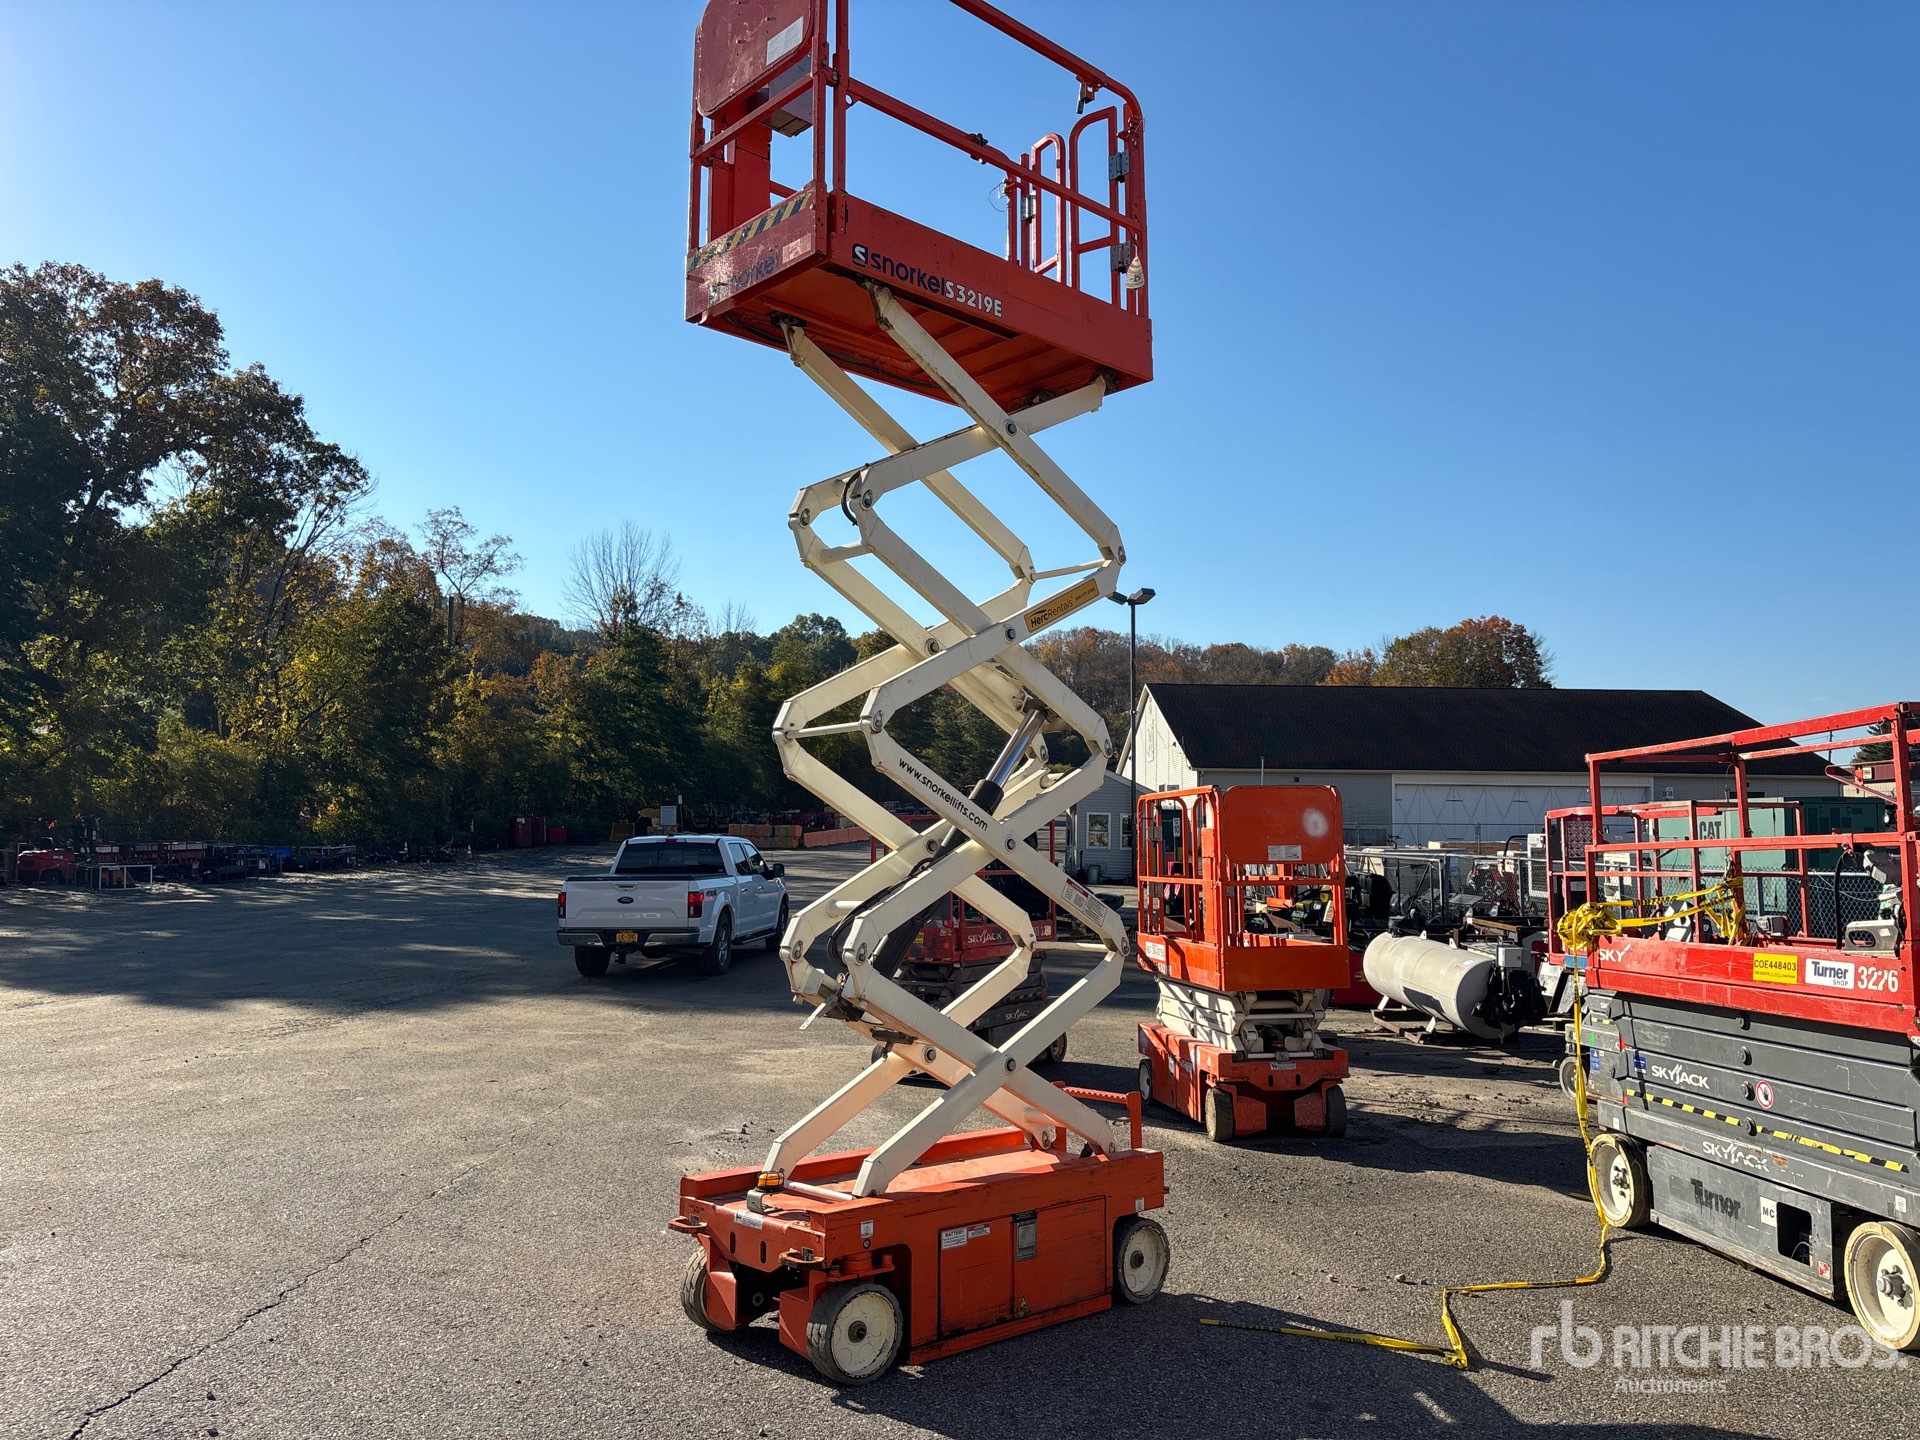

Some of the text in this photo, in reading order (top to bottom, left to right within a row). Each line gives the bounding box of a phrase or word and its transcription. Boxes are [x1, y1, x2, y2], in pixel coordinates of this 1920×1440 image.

[871, 252, 944, 296] snorkel
[945, 280, 1002, 317] S3219E
[899, 758, 988, 831] www.snorkellifts.com
[1699, 820, 1722, 840] CAT
[1754, 960, 1797, 972] COE448403
[1811, 961, 1849, 980] Turner
[1832, 979, 1849, 987] SHOP
[1651, 1063, 1710, 1090] SKYJACK
[1702, 1139, 1770, 1173] SKYJACK
[1691, 1178, 1741, 1220] Turner
[1762, 1206, 1775, 1219] MC
